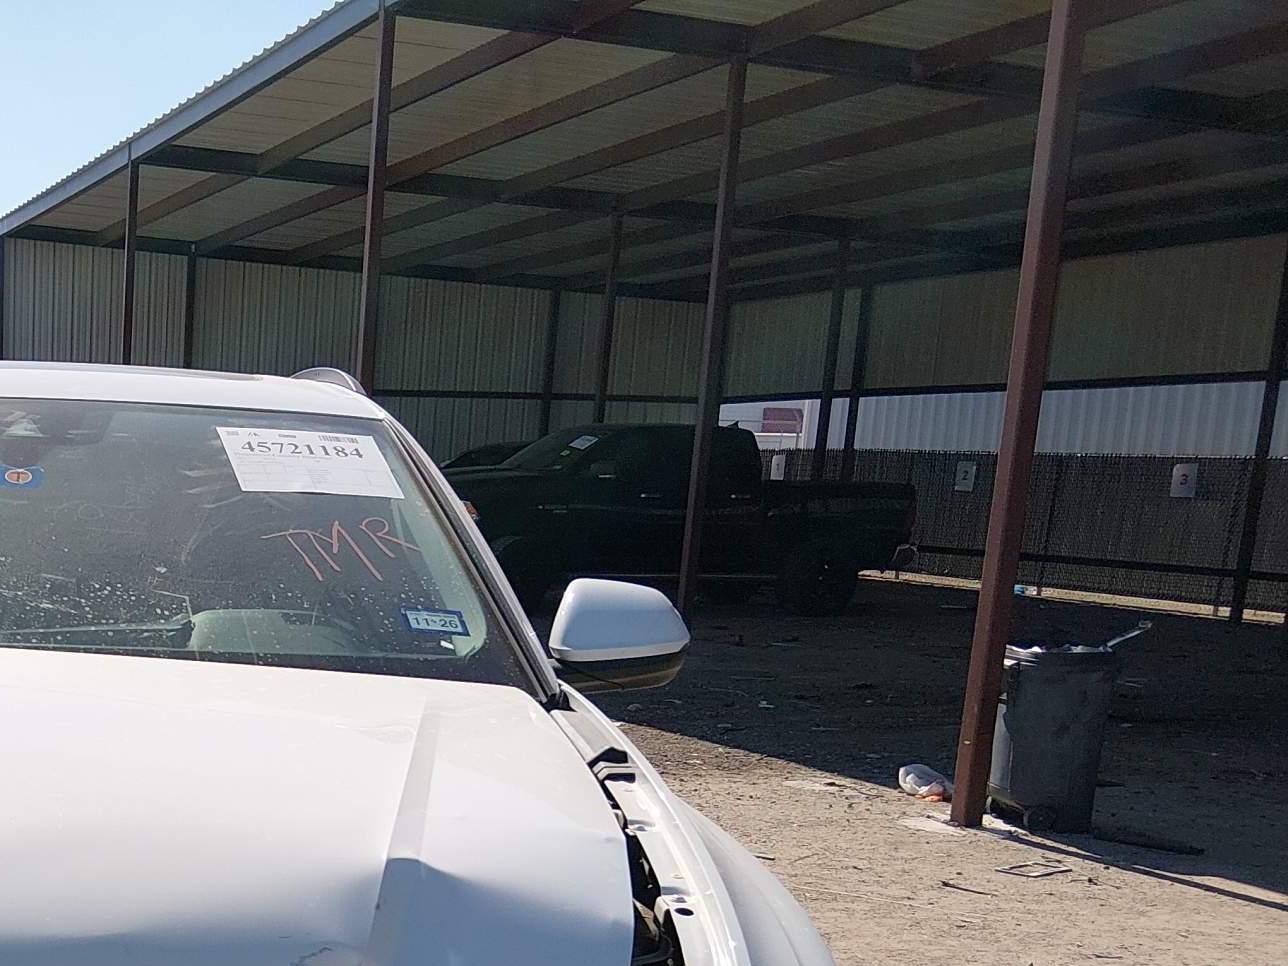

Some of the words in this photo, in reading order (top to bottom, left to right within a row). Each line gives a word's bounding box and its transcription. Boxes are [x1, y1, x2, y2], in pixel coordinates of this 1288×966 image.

[241, 441, 364, 459] 45721184
[962, 470, 969, 481] 2
[1179, 473, 1189, 486] 3
[260, 517, 421, 582] TMR
